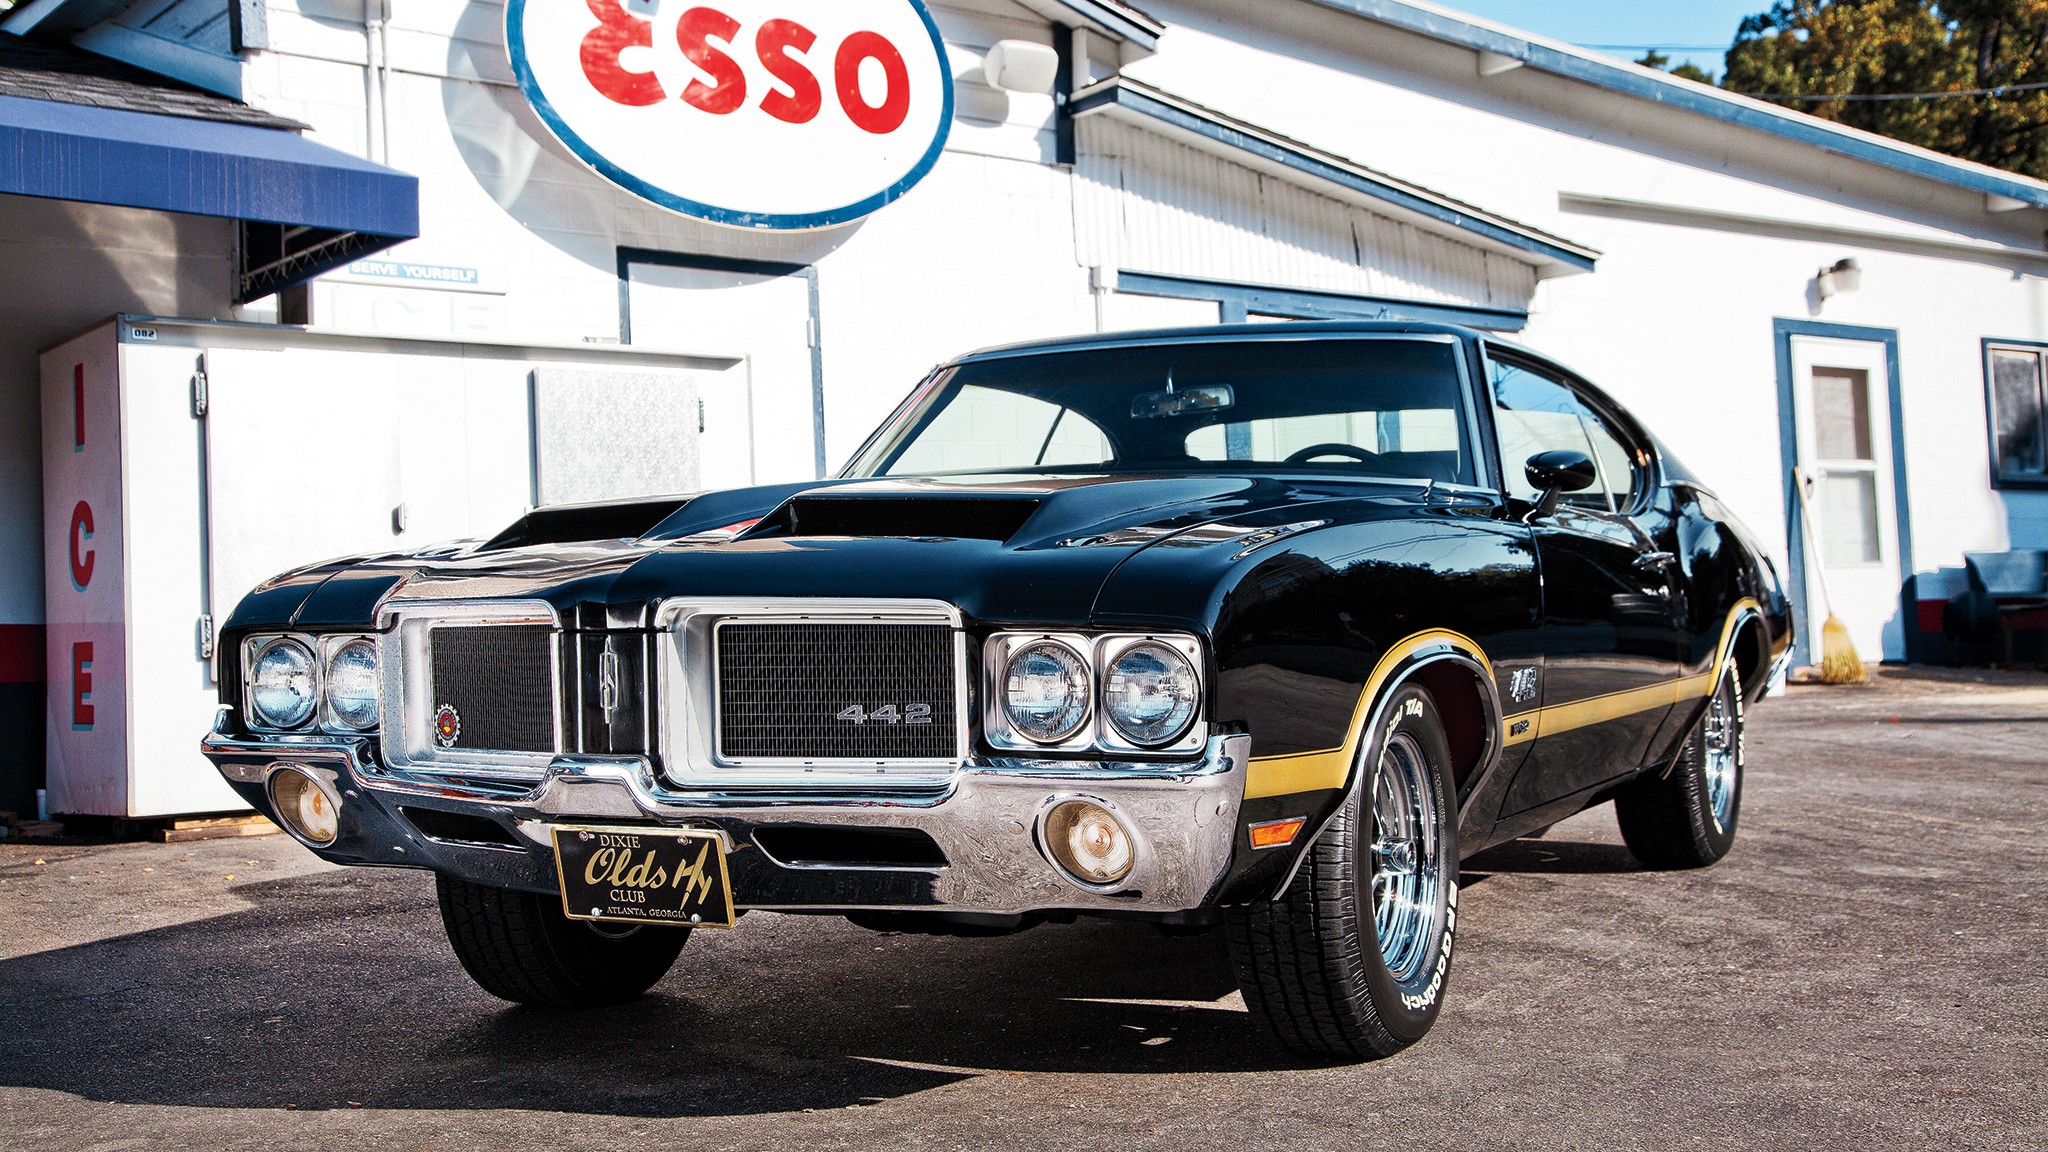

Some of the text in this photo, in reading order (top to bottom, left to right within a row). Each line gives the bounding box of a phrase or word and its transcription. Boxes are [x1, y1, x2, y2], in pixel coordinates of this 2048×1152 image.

[351, 261, 477, 283] SERVE YOURSELF
[69, 362, 95, 731] ICE
[836, 702, 932, 724] 442
[1405, 697, 1423, 718] T/A
[599, 834, 641, 849] DIXIE
[584, 848, 667, 889] Olds
[610, 890, 646, 904] CLUB
[606, 905, 688, 919] ATLANTA, GEORGIA
